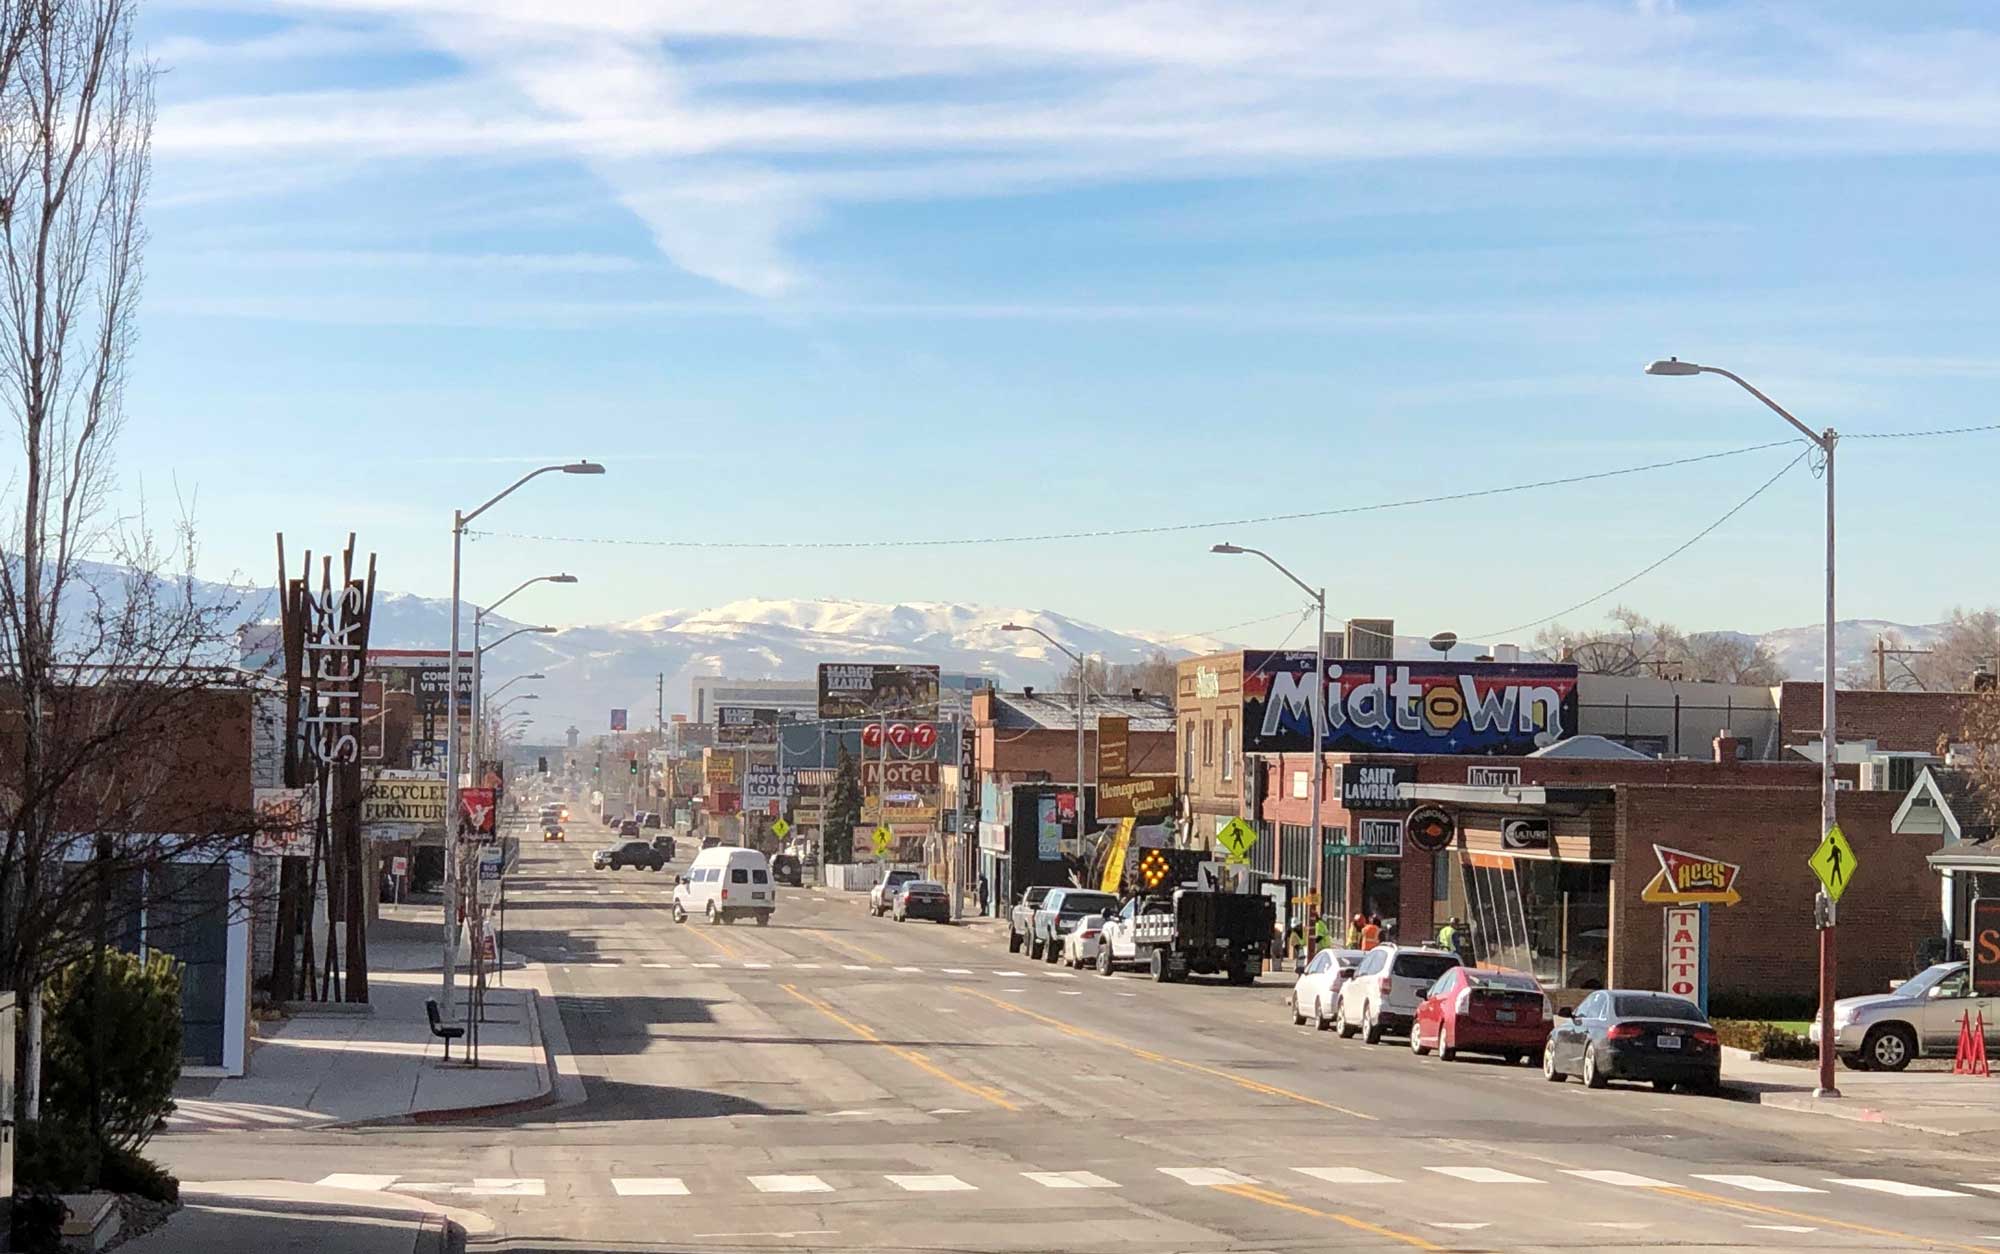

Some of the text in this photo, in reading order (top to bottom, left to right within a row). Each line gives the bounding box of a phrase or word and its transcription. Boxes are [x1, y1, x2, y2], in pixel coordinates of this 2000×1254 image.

[827, 666, 873, 679] MARCH
[438, 683, 473, 692] TOAY
[828, 679, 873, 690] MANIA
[749, 774, 795, 784] MOTOR
[867, 764, 932, 783] Motel
[1360, 768, 1396, 784] SAINT
[750, 786, 793, 796] LODGE
[1344, 783, 1402, 800] LAWRENC
[366, 804, 448, 818] FURNITUR
